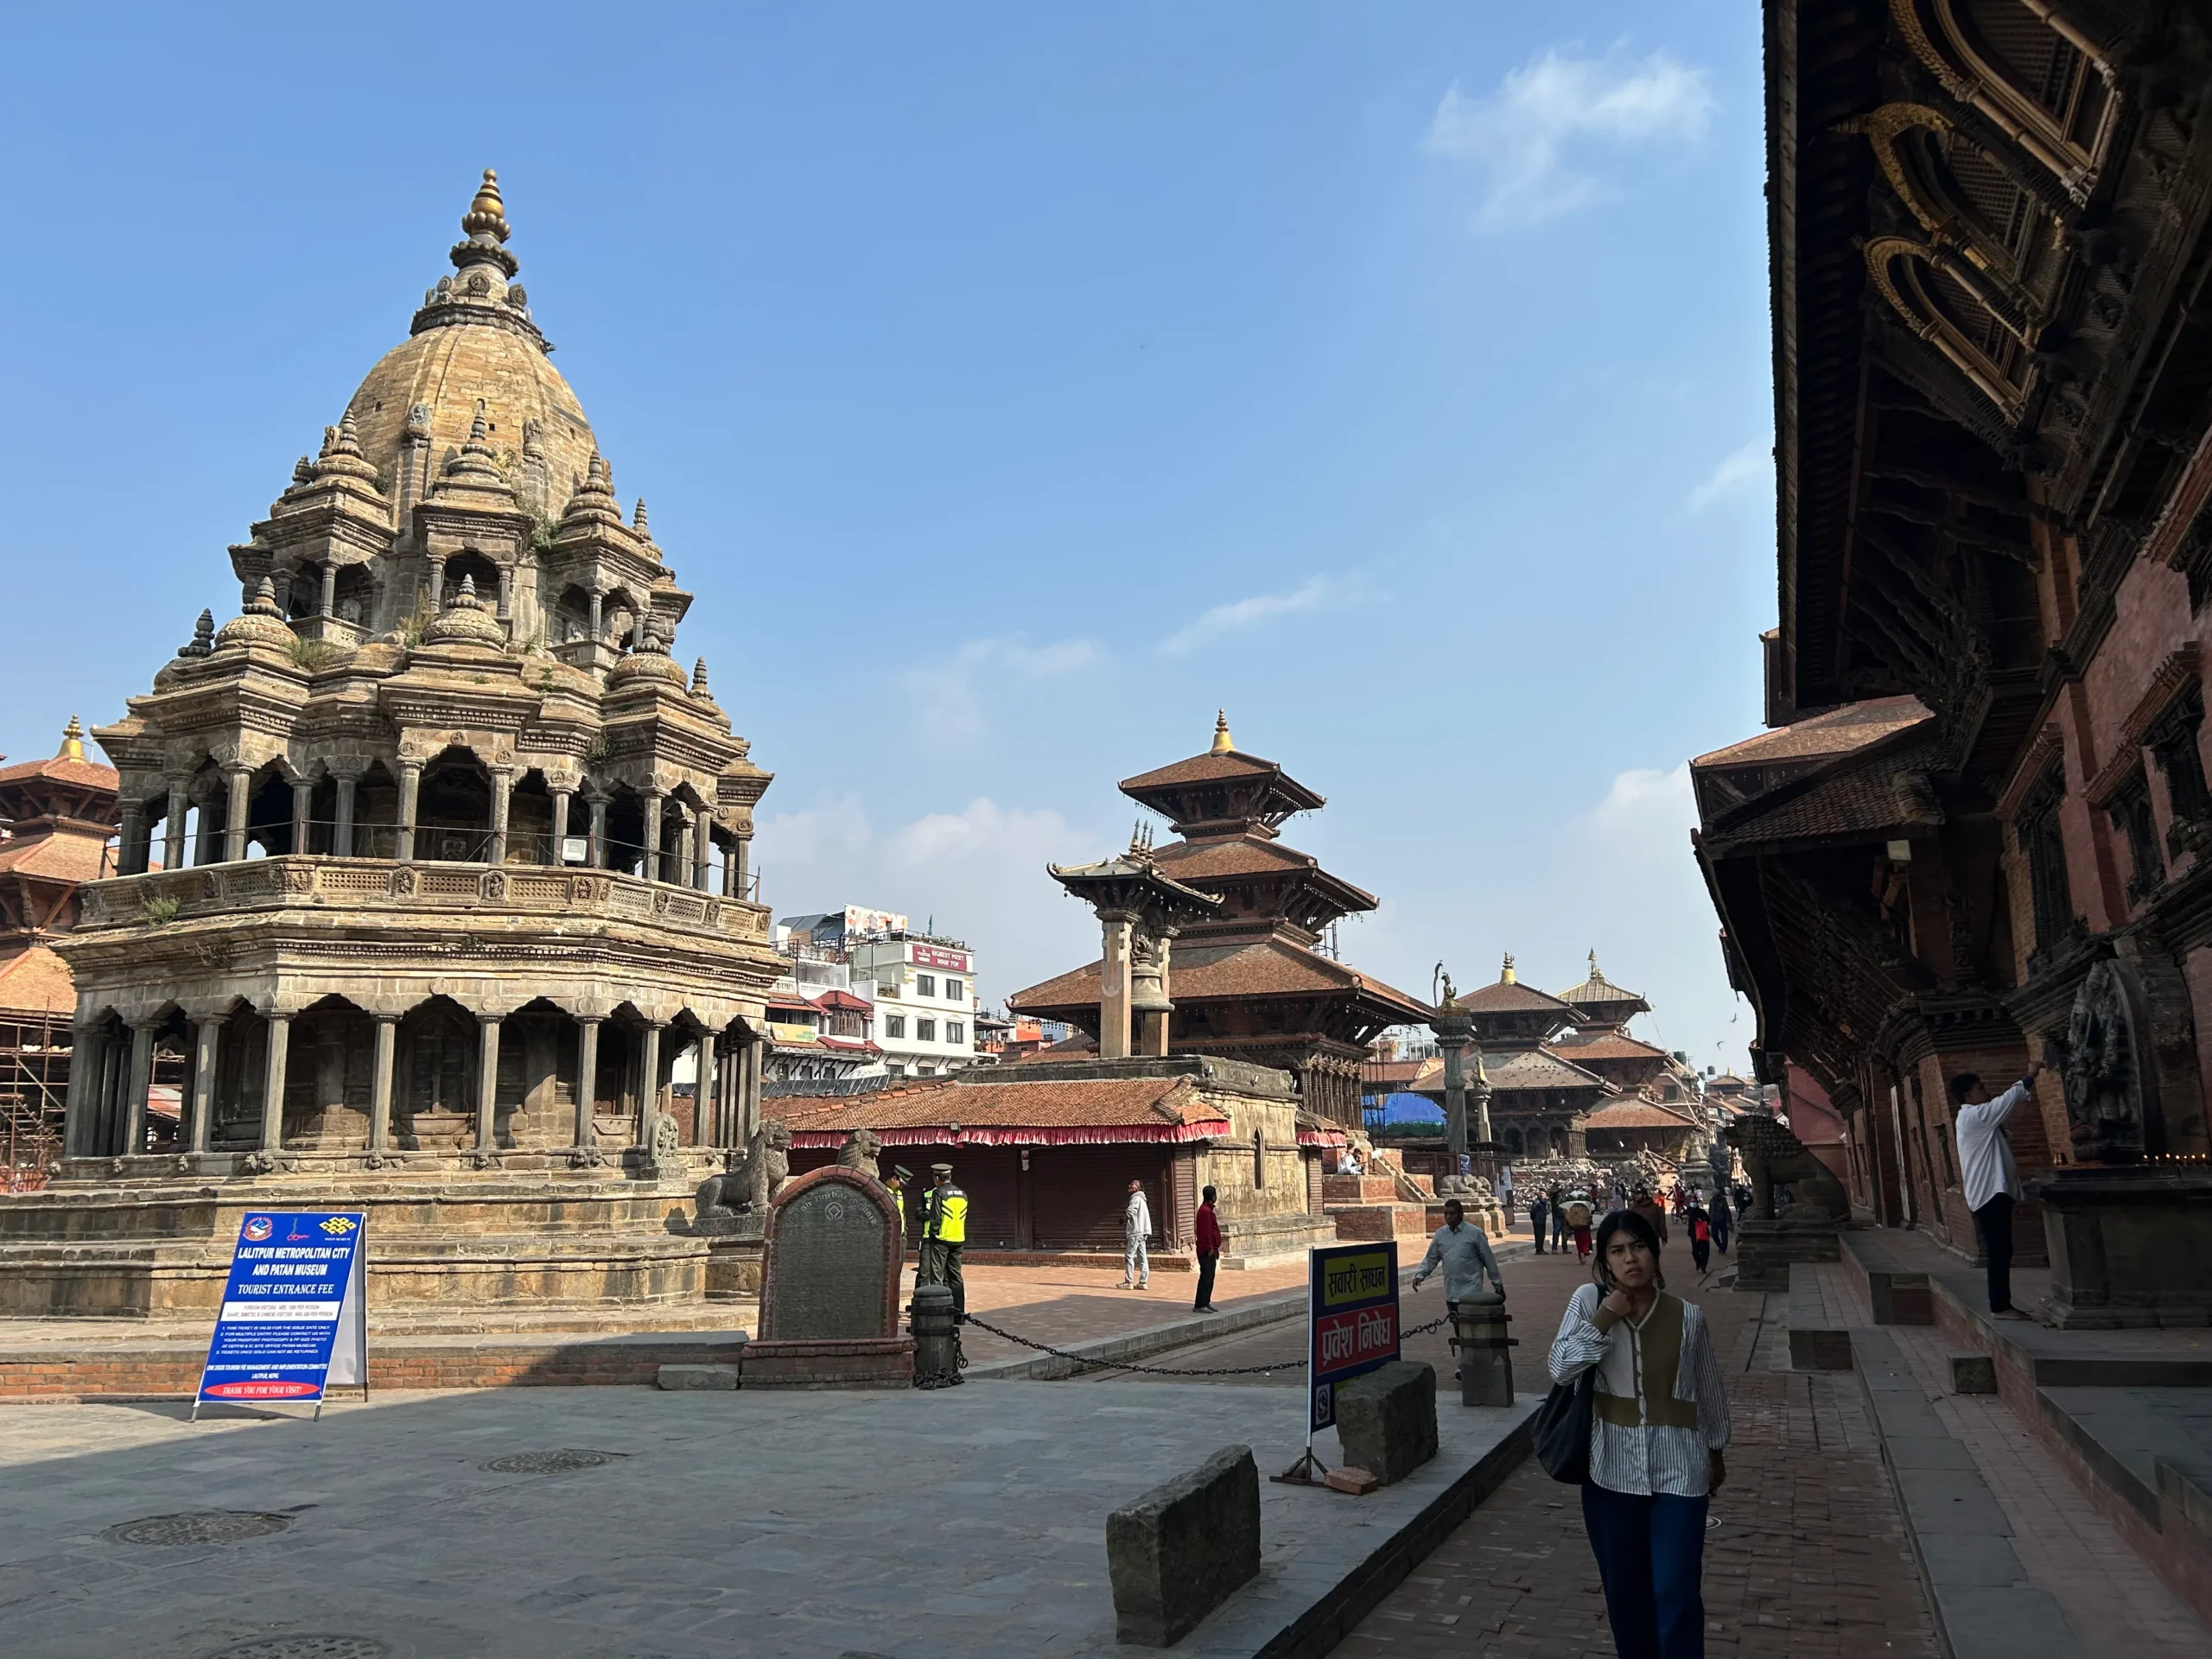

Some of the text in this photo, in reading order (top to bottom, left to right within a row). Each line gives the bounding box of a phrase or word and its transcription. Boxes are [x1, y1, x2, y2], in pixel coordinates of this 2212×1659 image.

[931, 950, 950, 958] HIGHEST
[814, 1191, 849, 1202] Durbar
[852, 1198, 877, 1224] Square
[238, 1247, 351, 1259] LALITPUR METROPOLITAN CITY
[252, 1264, 328, 1276] AND PATAN MUSEUM
[1327, 1262, 1385, 1298] सवारी साधन
[238, 1284, 334, 1294] TOURIST ENTRANCE FEE
[1322, 1310, 1391, 1367] प्रवेश निषेध
[243, 1386, 255, 1395] YOU
